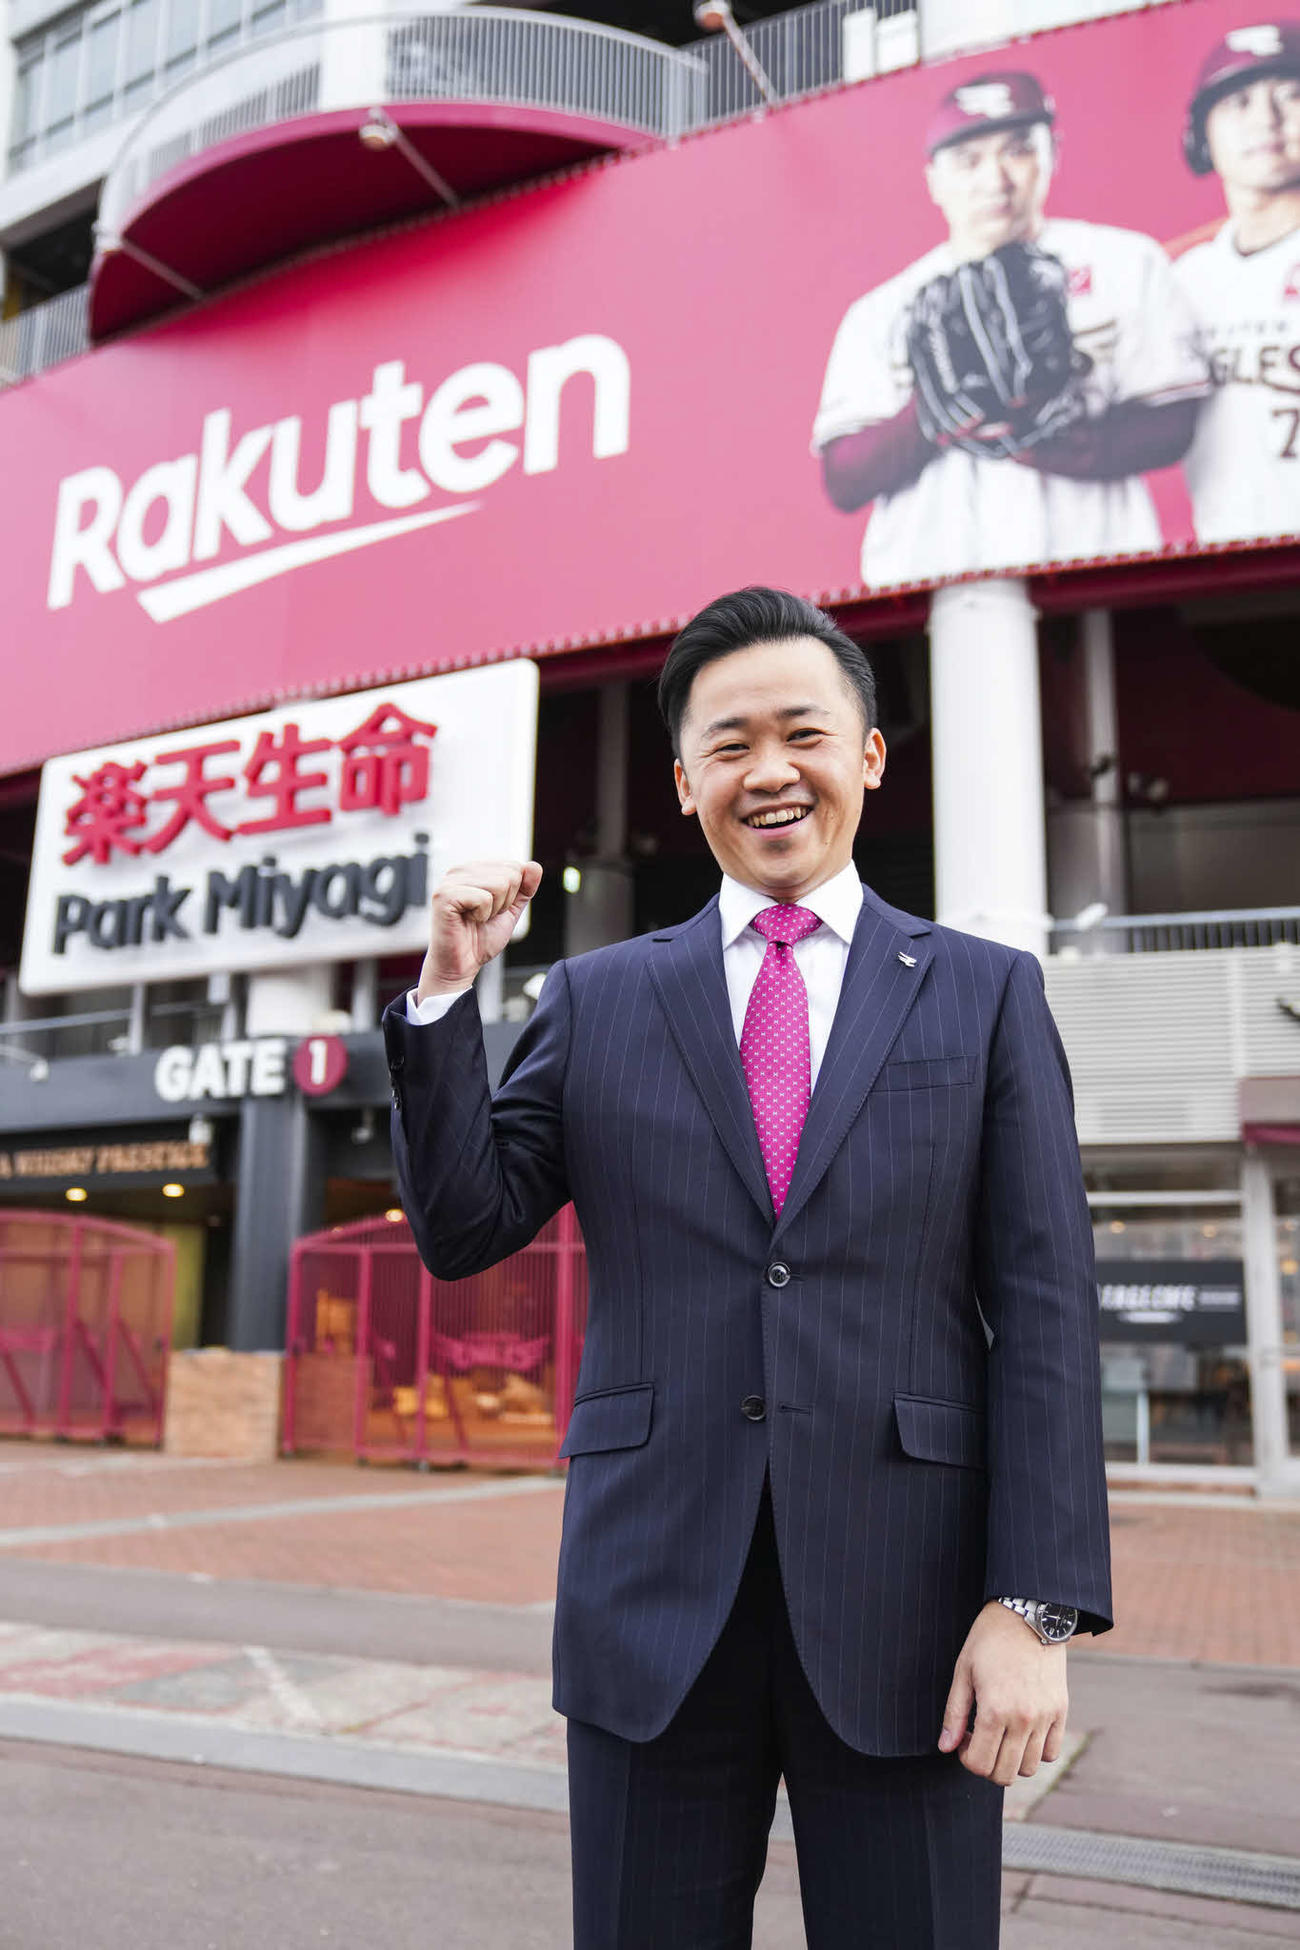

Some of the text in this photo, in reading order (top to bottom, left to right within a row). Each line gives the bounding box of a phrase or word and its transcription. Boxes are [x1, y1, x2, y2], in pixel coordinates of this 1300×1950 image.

[47, 334, 631, 610] Rakuten
[62, 702, 438, 866] 楽天生命
[53, 832, 429, 955] Park Miyagi
[155, 1039, 327, 1102] GATE 1
